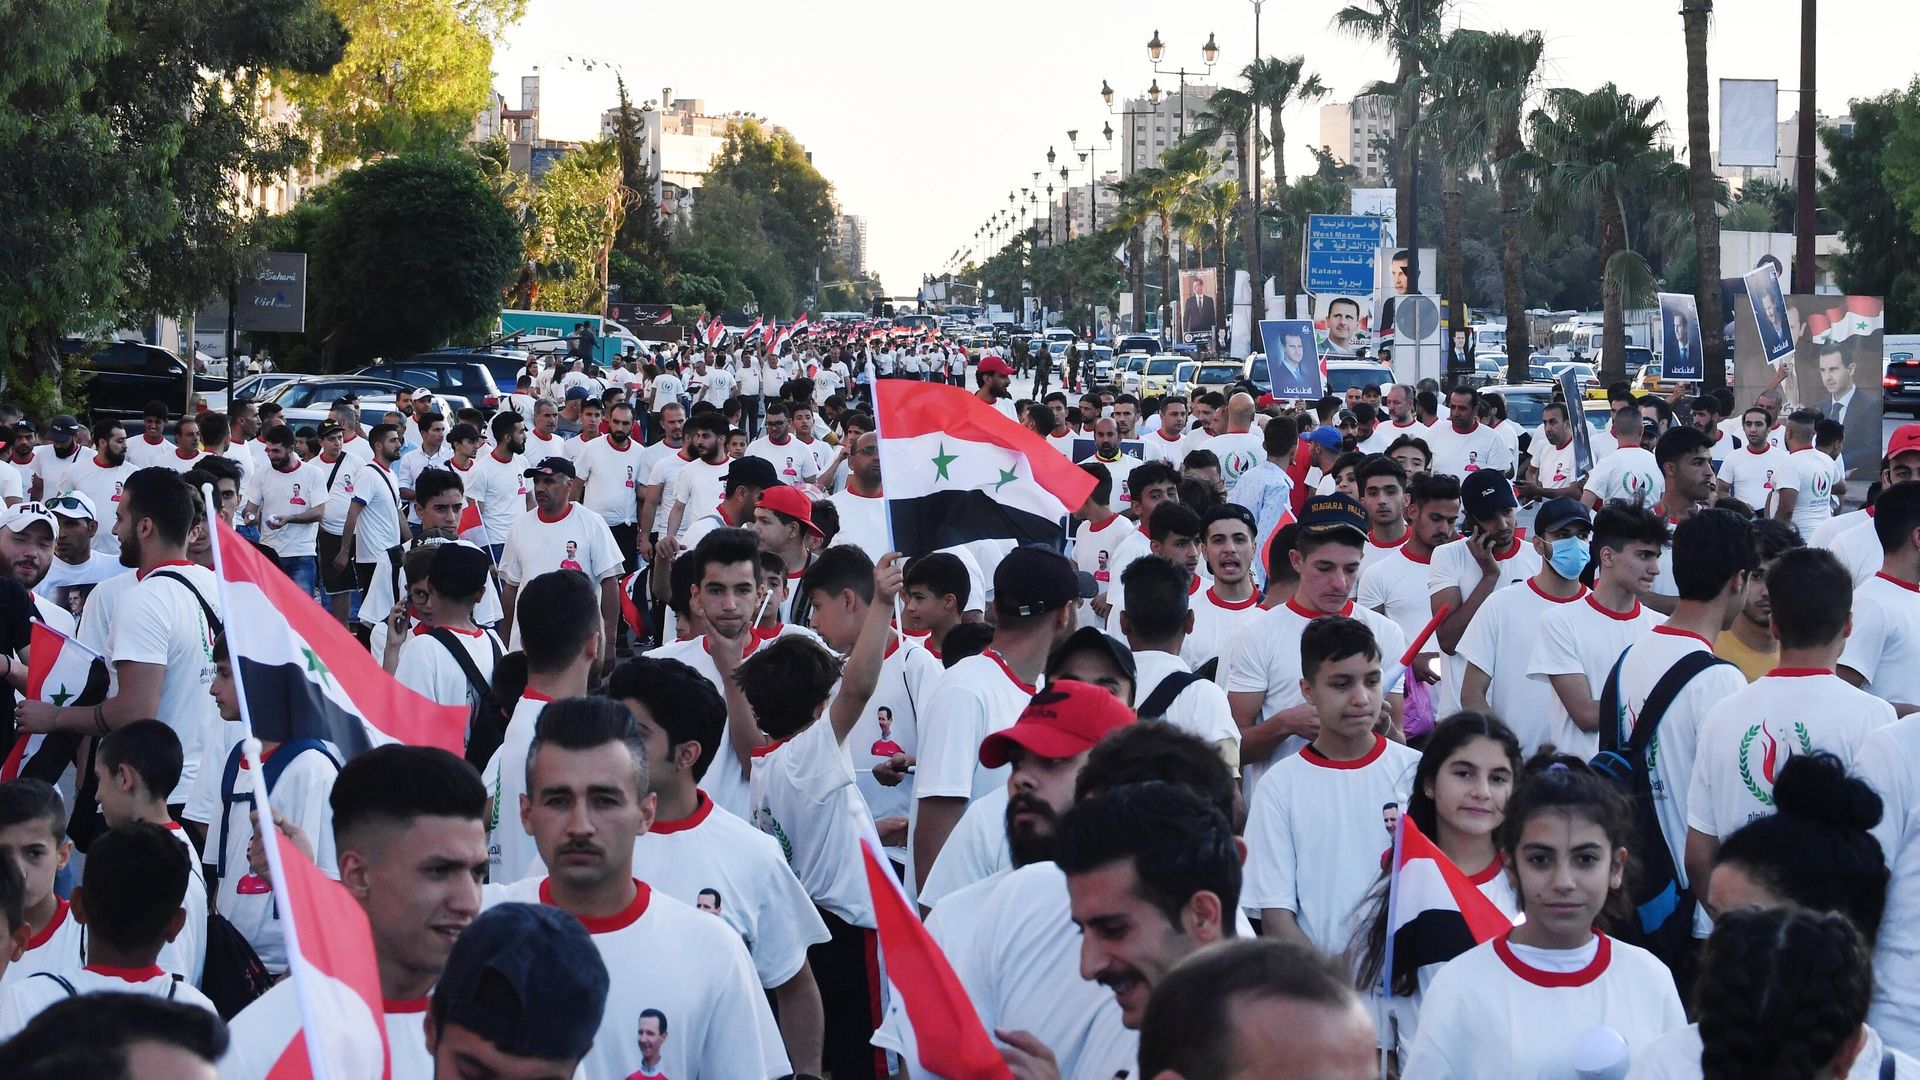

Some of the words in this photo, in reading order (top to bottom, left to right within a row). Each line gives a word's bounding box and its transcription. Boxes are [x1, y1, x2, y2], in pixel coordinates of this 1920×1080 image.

[1319, 218, 1345, 230] غربية
[1330, 255, 1362, 264] قطنا
[1311, 267, 1342, 275] Katana
[1337, 278, 1362, 288] بيروت
[1312, 502, 1343, 512] NIAGARA
